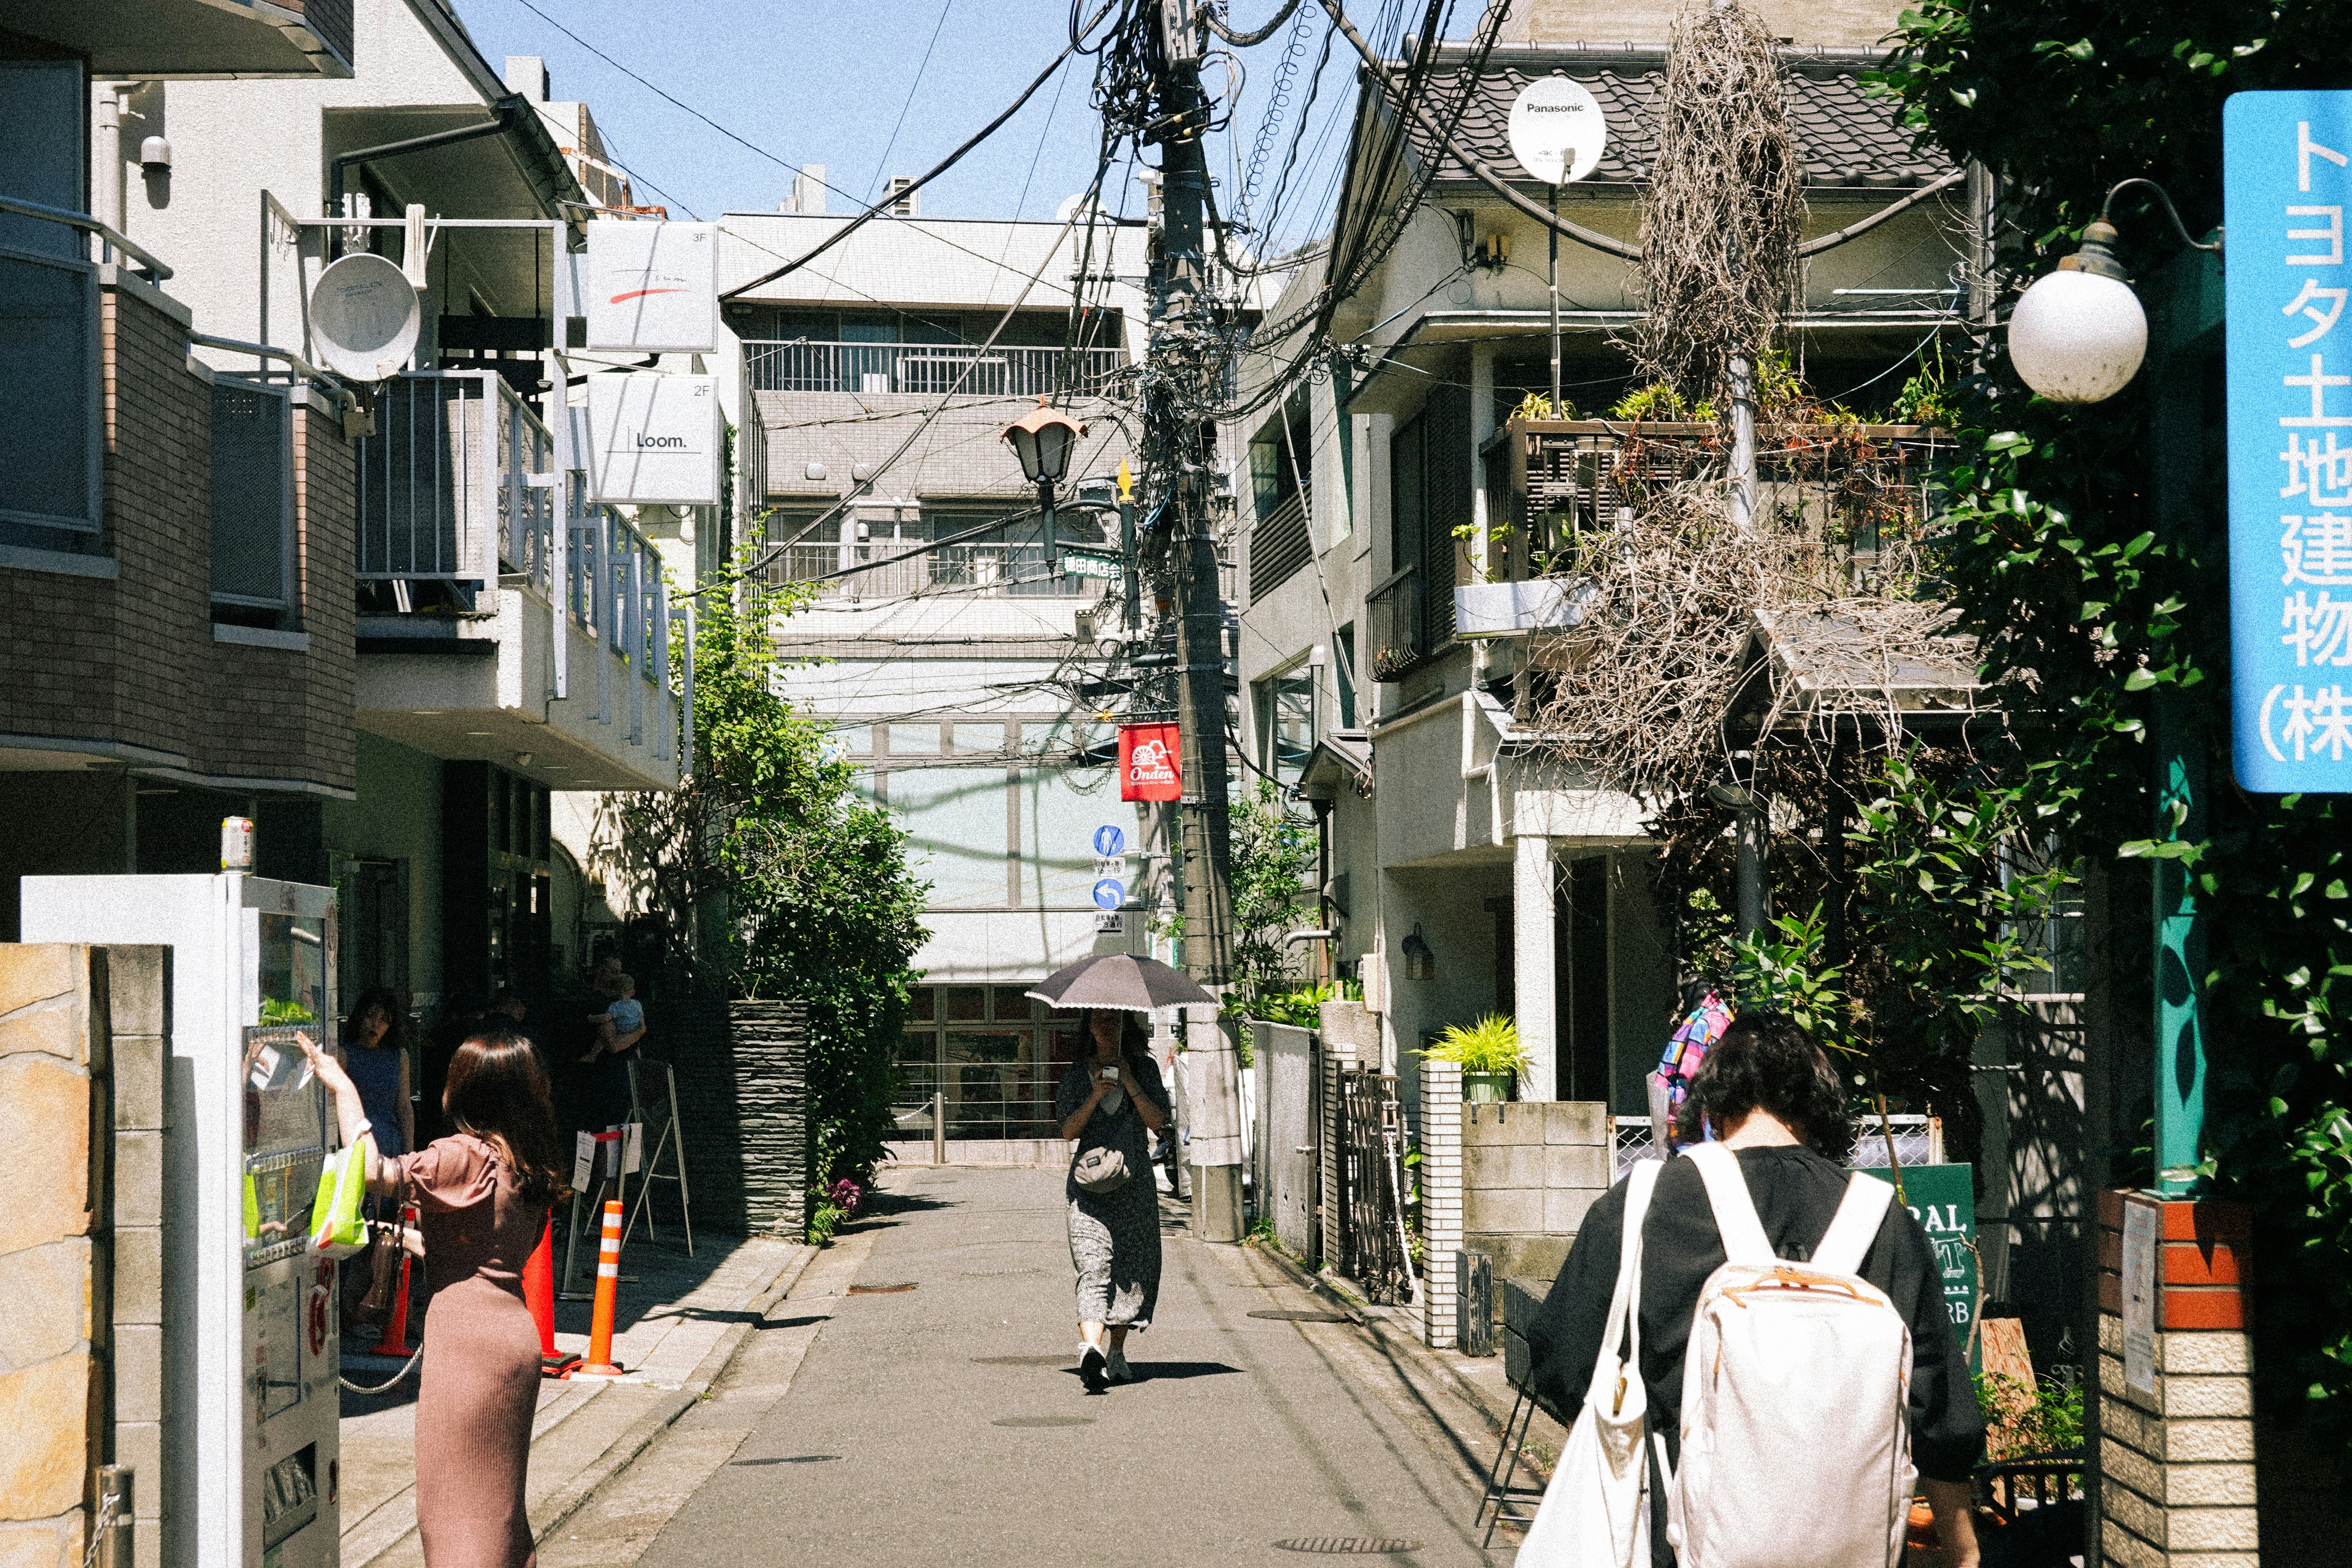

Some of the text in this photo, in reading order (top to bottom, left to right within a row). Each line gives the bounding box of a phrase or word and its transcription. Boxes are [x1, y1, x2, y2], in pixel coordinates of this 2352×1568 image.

[1528, 104, 1583, 112] Panasonic
[693, 233, 706, 242] 3F
[694, 386, 710, 396] 2F
[637, 433, 686, 448] Loom.
[1064, 556, 1121, 579] 穏田商店会
[1130, 766, 1174, 781] Onden
